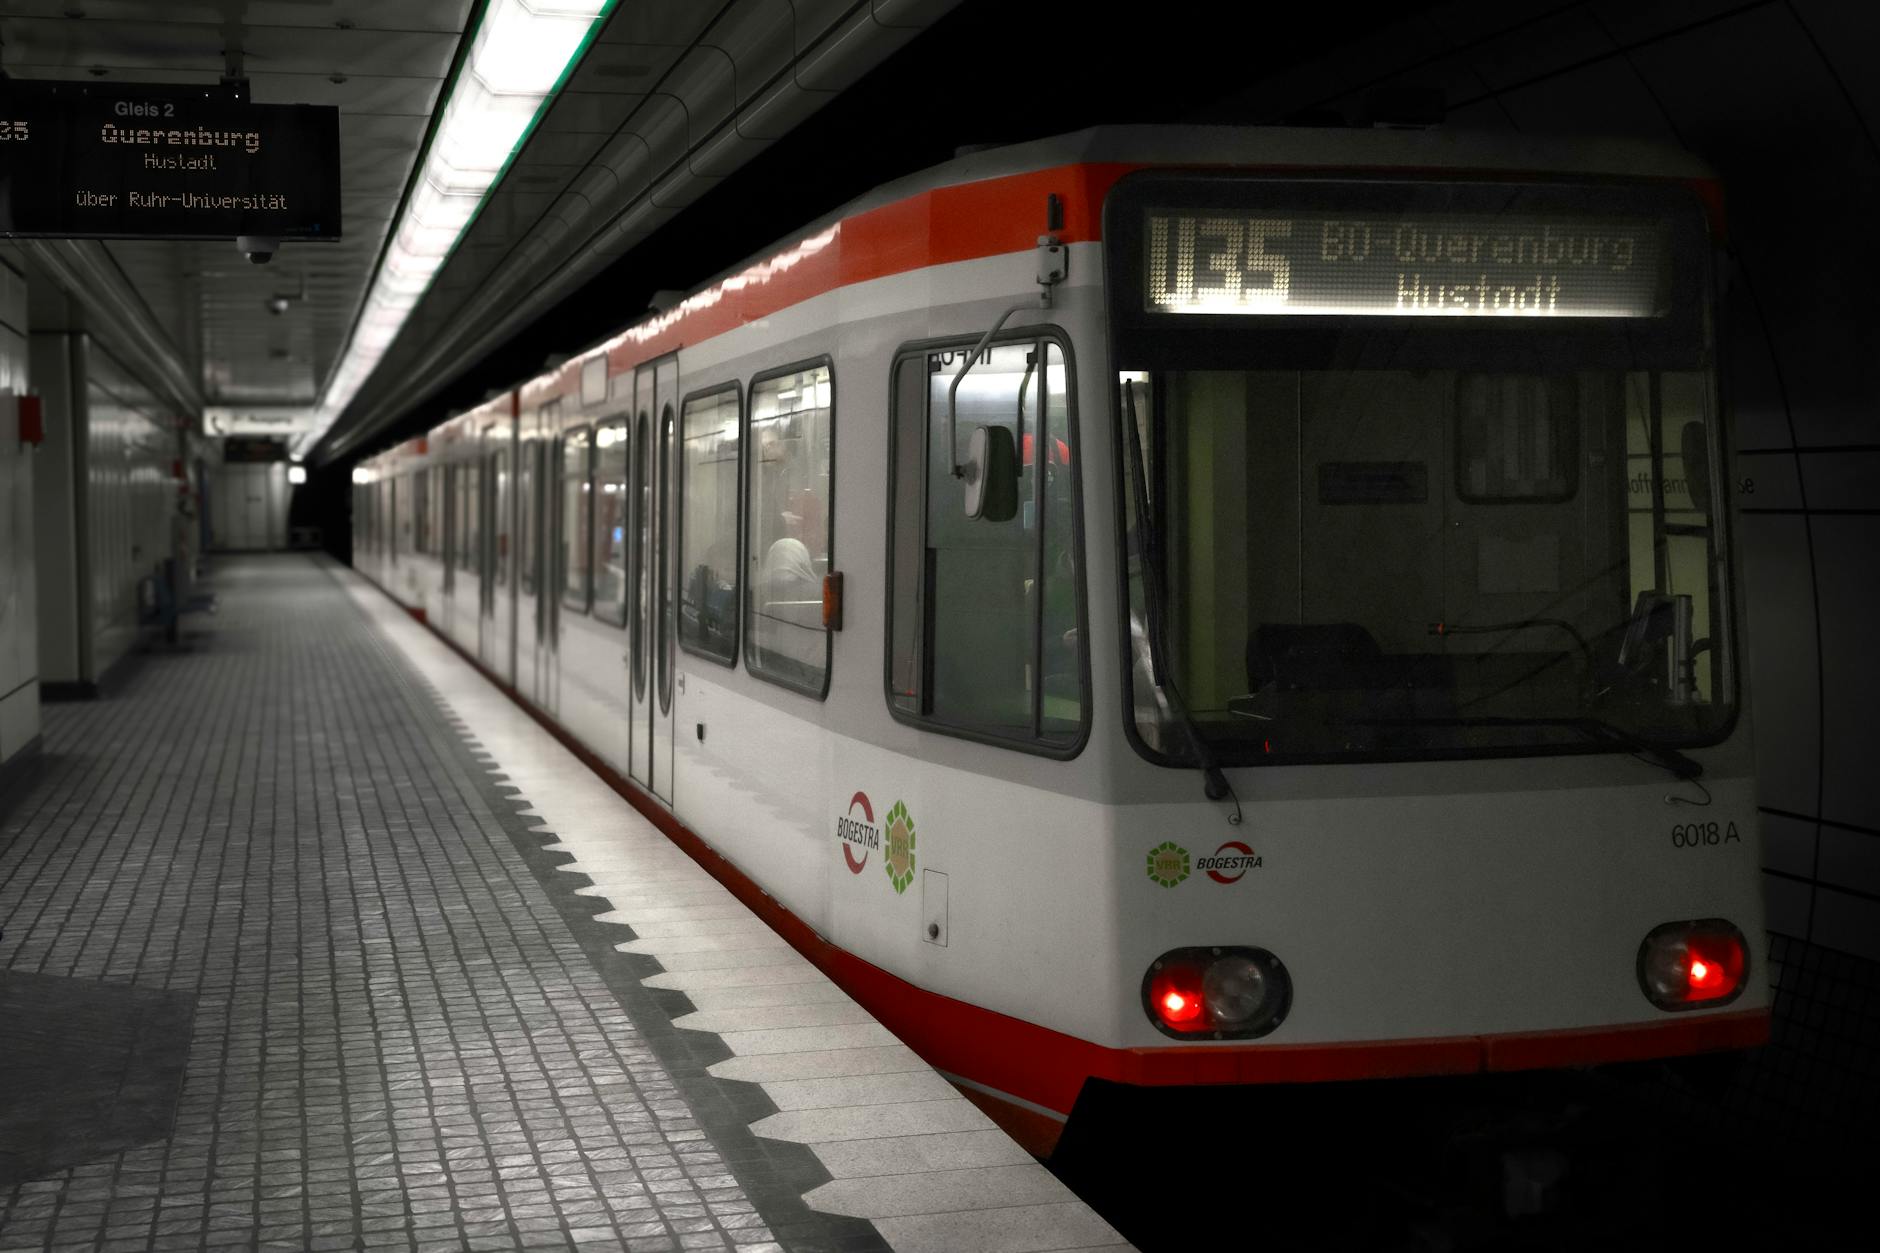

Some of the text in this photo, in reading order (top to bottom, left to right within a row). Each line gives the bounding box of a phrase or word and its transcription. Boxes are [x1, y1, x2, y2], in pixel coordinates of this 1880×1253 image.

[114, 101, 176, 118] Gleis 2
[101, 124, 261, 154] Querenburg
[143, 153, 217, 170] Hustadt
[75, 191, 289, 210] über Ruhr-Universität
[1320, 219, 1635, 271] BO-Querenburg
[1149, 216, 1292, 308] U35
[1396, 272, 1562, 313] Hustadt
[836, 816, 880, 851] BOGESTRA
[1672, 821, 1741, 848] 6018 A
[1196, 856, 1263, 870] BOGESTRA
